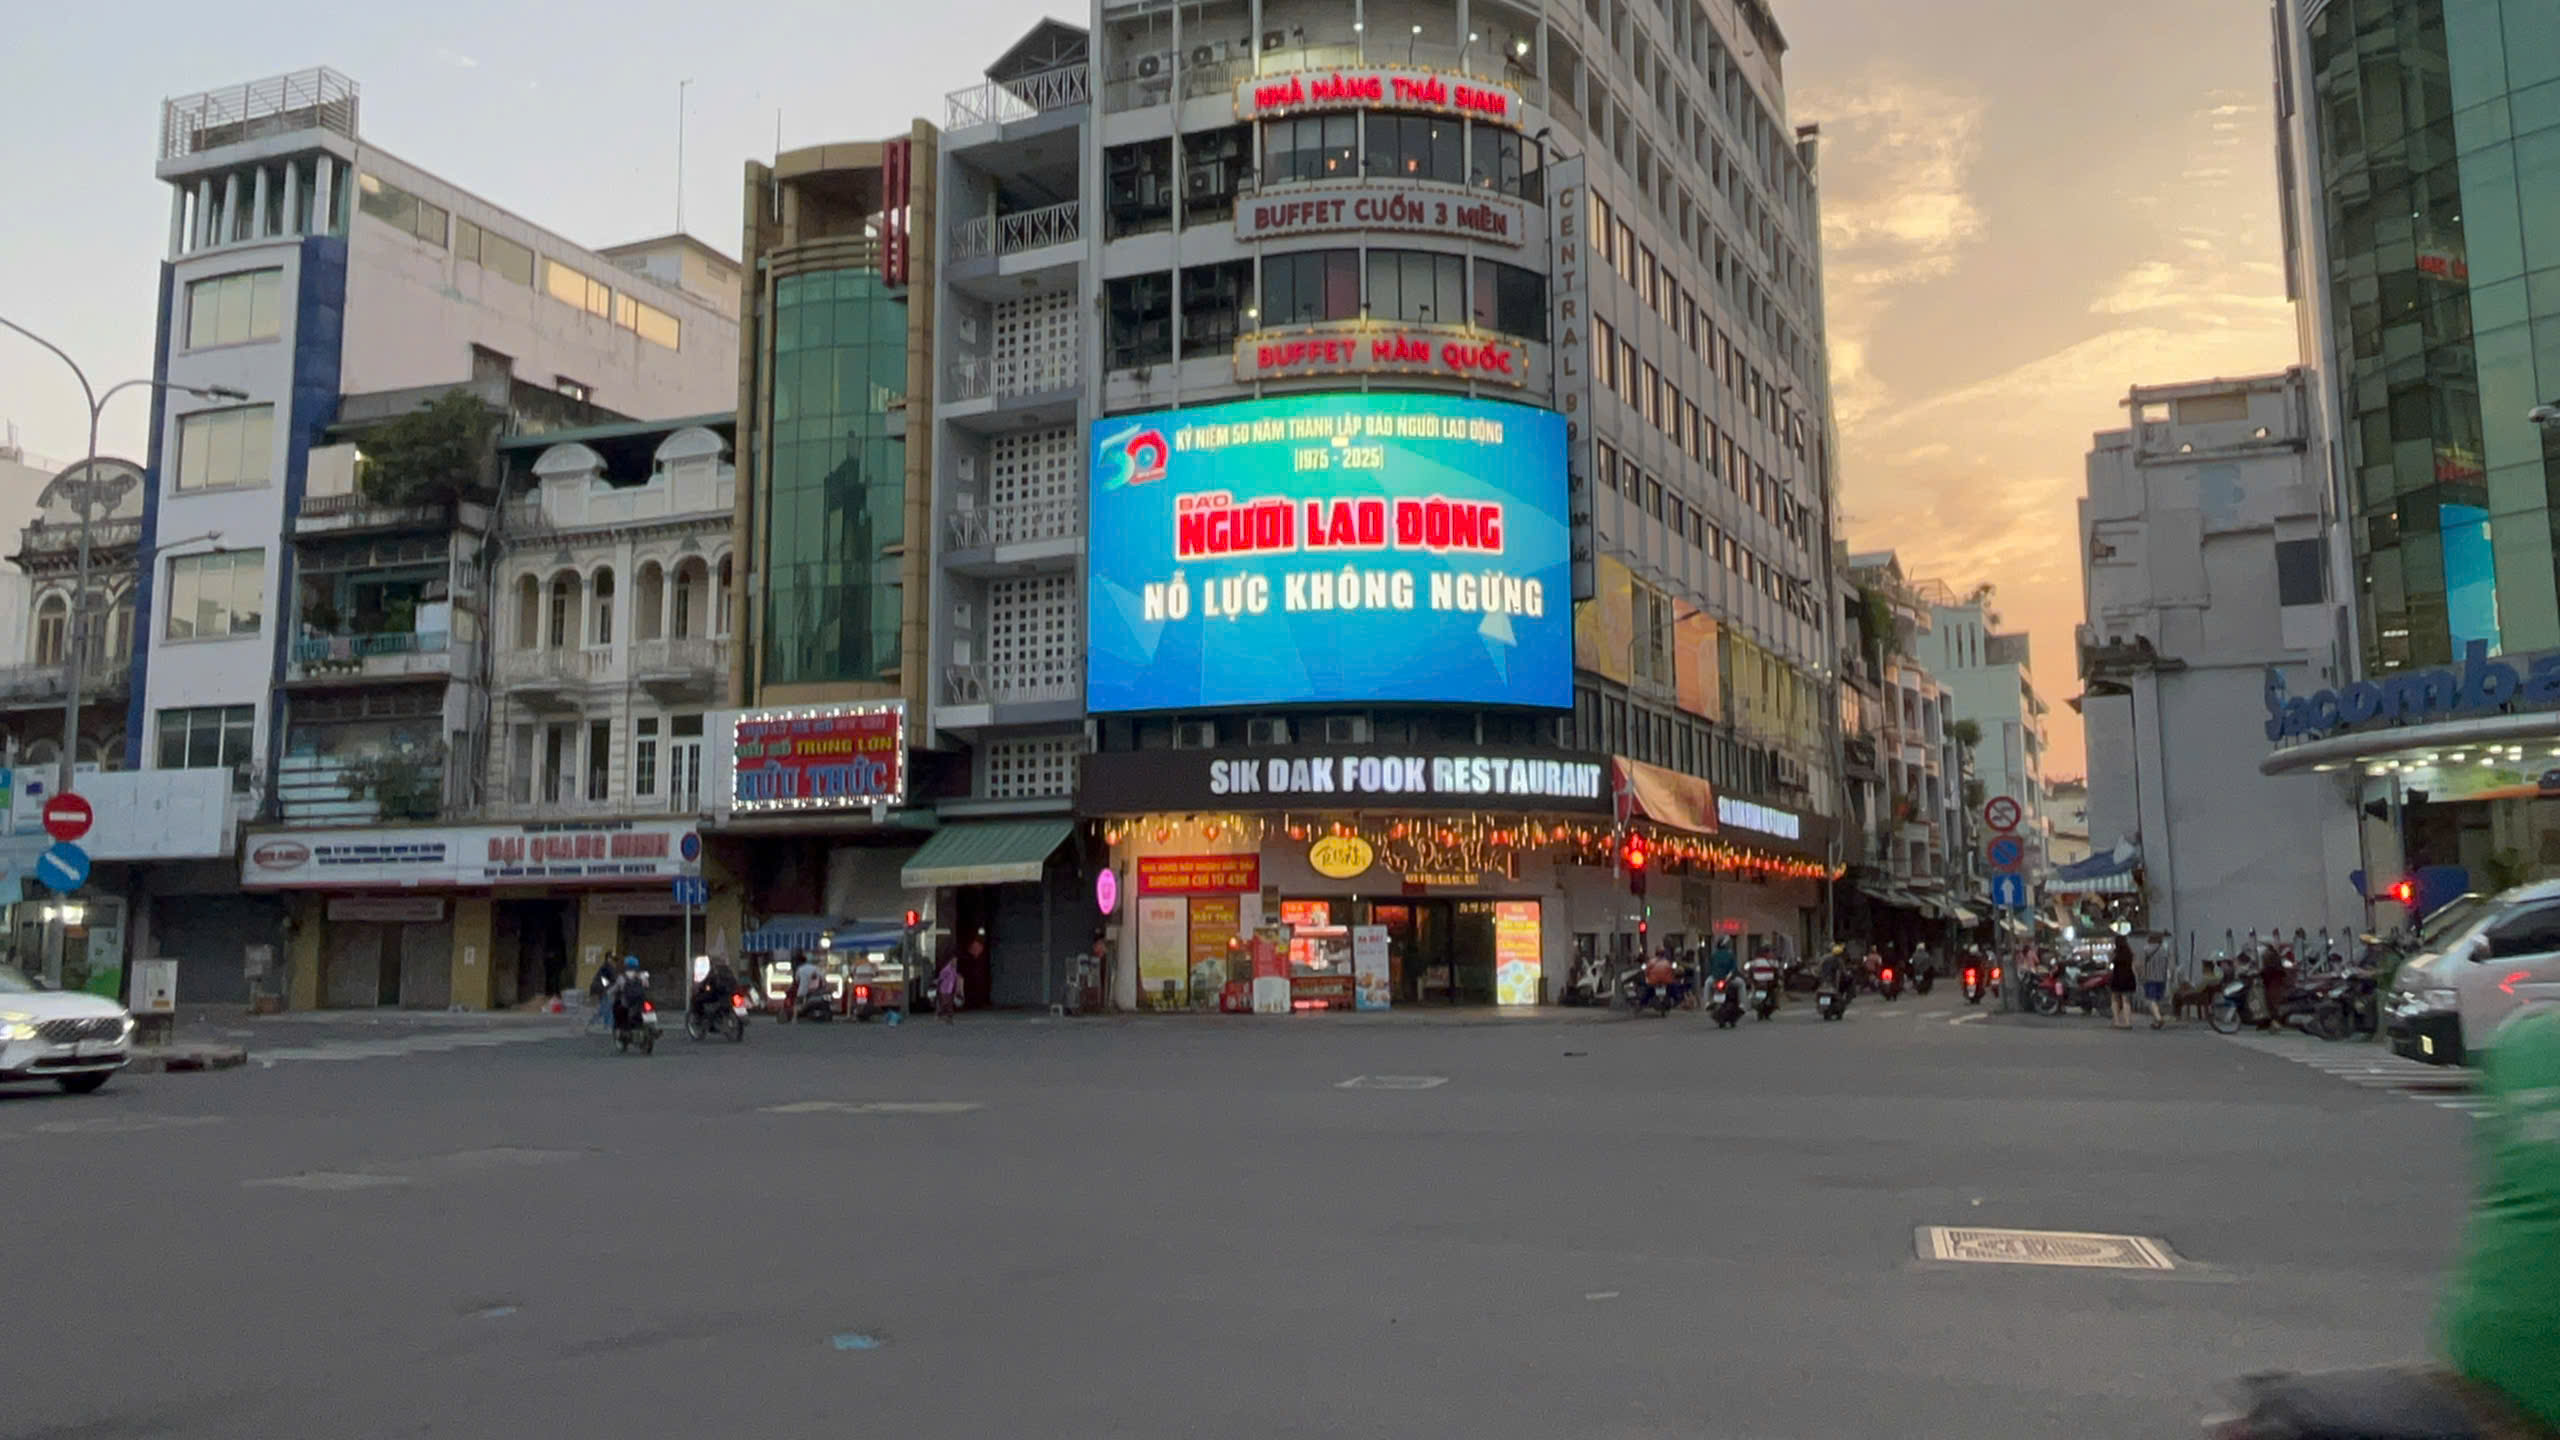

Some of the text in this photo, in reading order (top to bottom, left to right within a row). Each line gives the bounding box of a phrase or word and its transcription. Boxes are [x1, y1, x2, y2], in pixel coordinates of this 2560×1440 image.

[1254, 75, 1304, 110] NHÀ
[1391, 74, 1448, 105] THÁI
[1453, 83, 1508, 116] SIAM
[1255, 199, 1346, 230] BUFFET
[1353, 194, 1425, 224] CUỐN
[1434, 203, 1448, 226] 3
[1559, 187, 1578, 377] CENTRAL
[1257, 333, 1513, 375] BUFFET HÀN QUỐC
[1232, 425, 1250, 444] 50
[1442, 417, 1467, 439] LAO
[1178, 497, 1502, 557] NGƯỜI LAO ĐỘNG
[1203, 571, 1268, 622] LỰC
[1285, 563, 1414, 612] KHÔNG
[1430, 570, 1544, 618] NGỪNG
[1210, 755, 1601, 799] SIK DAK FOOK RESTAURANT
